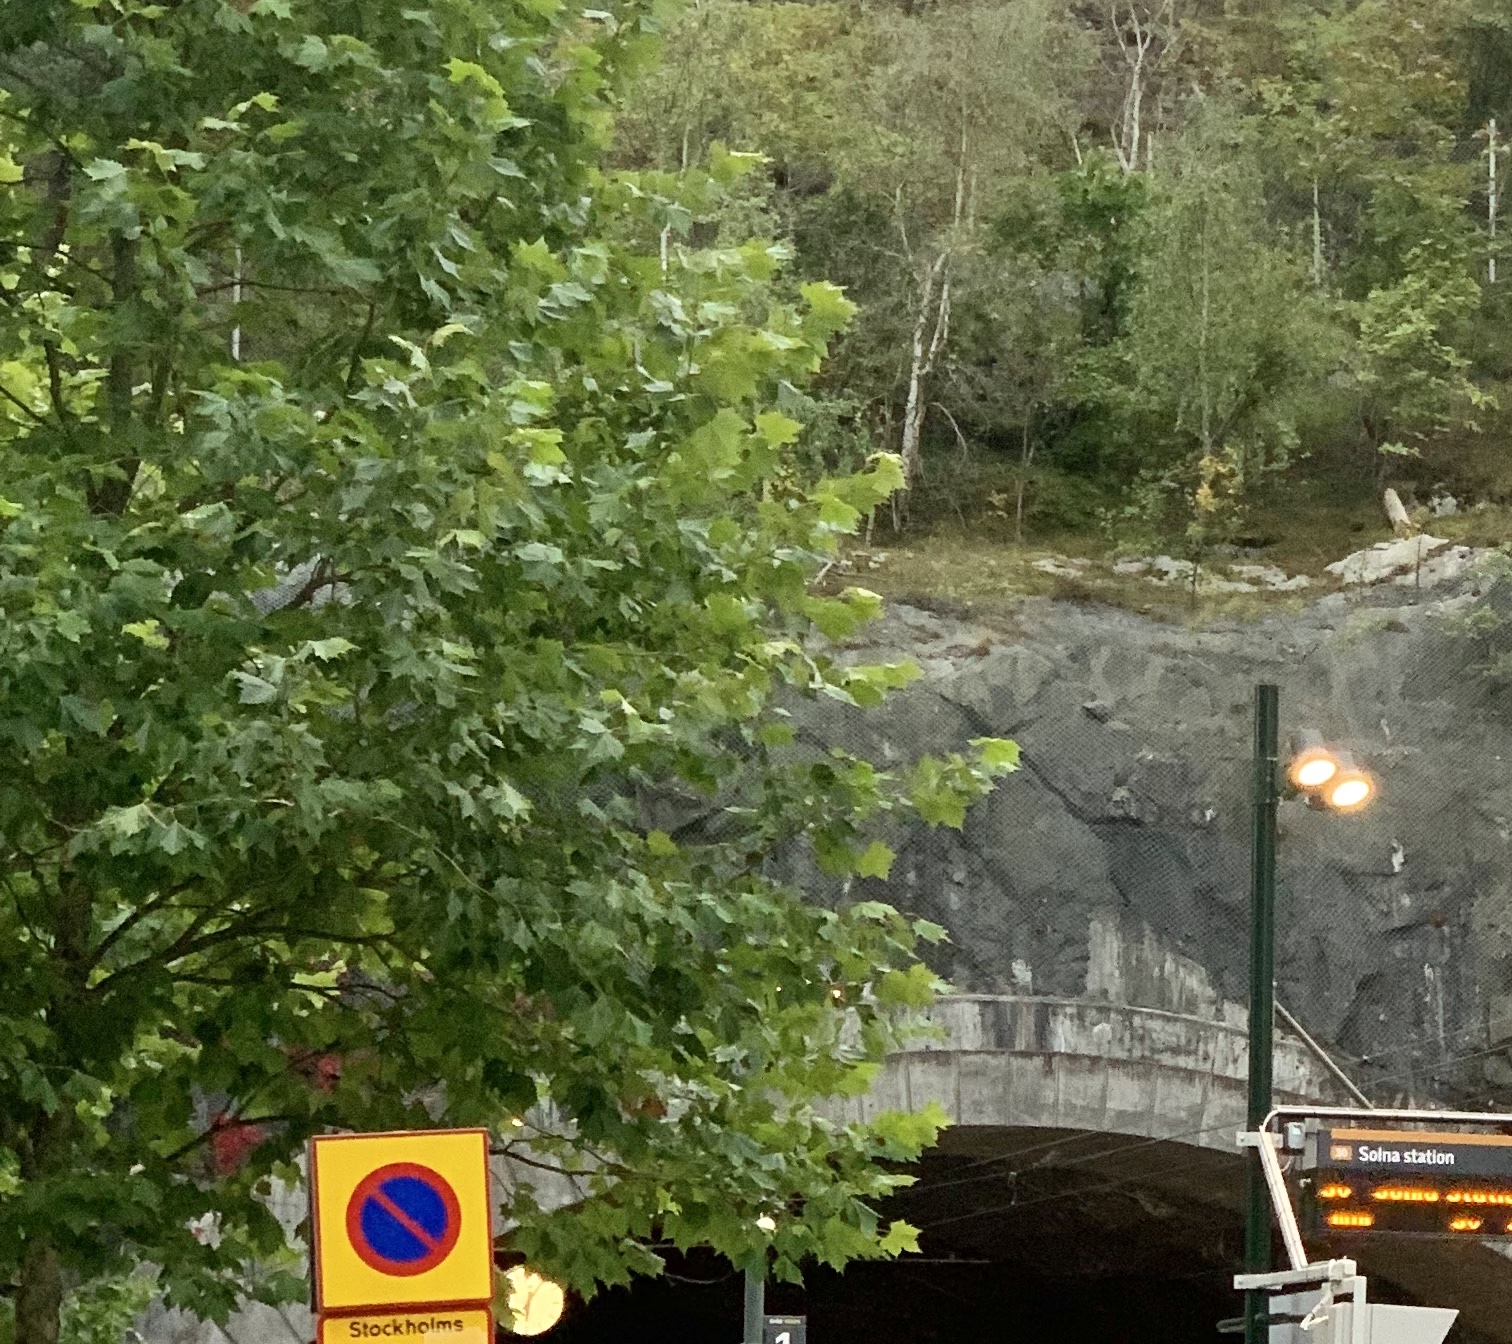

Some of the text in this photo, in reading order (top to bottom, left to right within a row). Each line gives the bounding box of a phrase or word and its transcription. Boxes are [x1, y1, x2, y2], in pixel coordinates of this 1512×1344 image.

[1358, 1146, 1400, 1163] Solna
[1404, 1148, 1455, 1165] station
[350, 1318, 463, 1338] Stockholms
